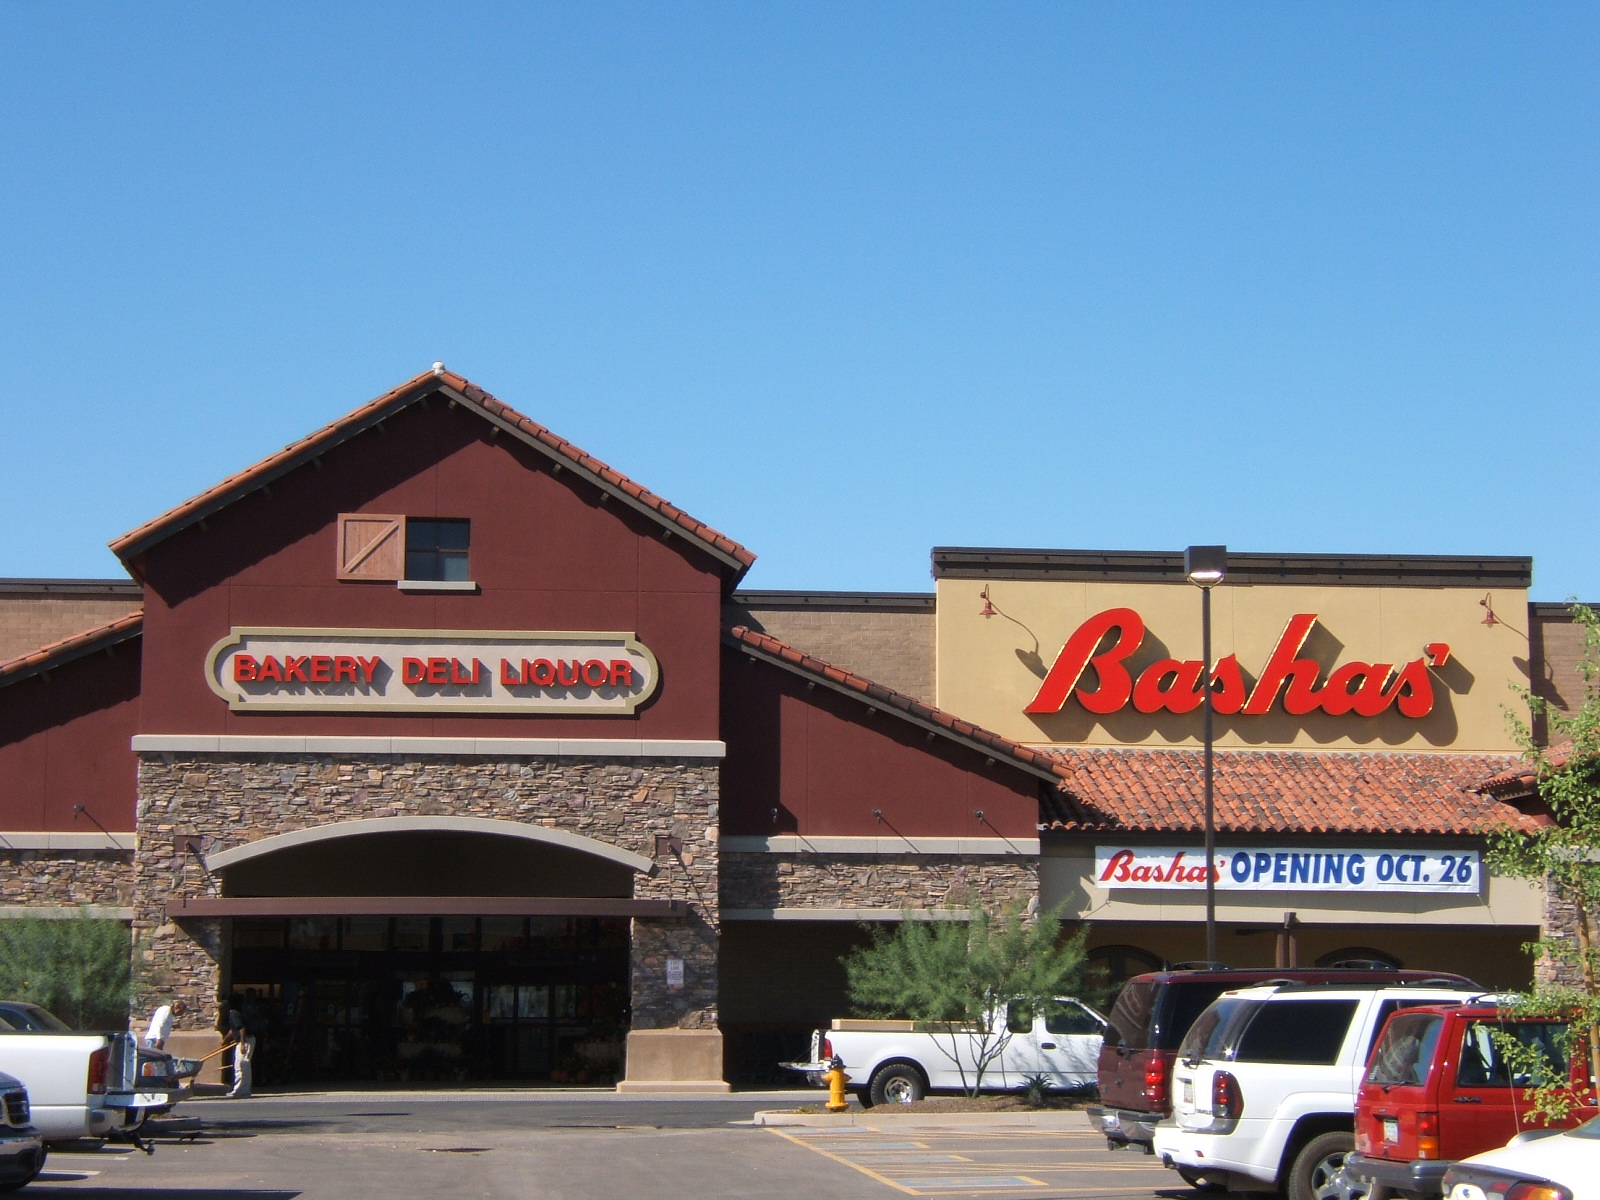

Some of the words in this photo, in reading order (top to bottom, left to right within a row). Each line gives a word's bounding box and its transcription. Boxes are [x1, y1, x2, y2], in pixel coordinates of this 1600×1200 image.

[234, 654, 380, 683] BAKERY
[402, 657, 480, 685] DELI
[501, 658, 633, 687] LIQUOR
[1024, 607, 1451, 718] Bashas'
[1231, 851, 1365, 884] OPENING
[1376, 854, 1429, 882] OCT.
[1440, 855, 1472, 883] 26
